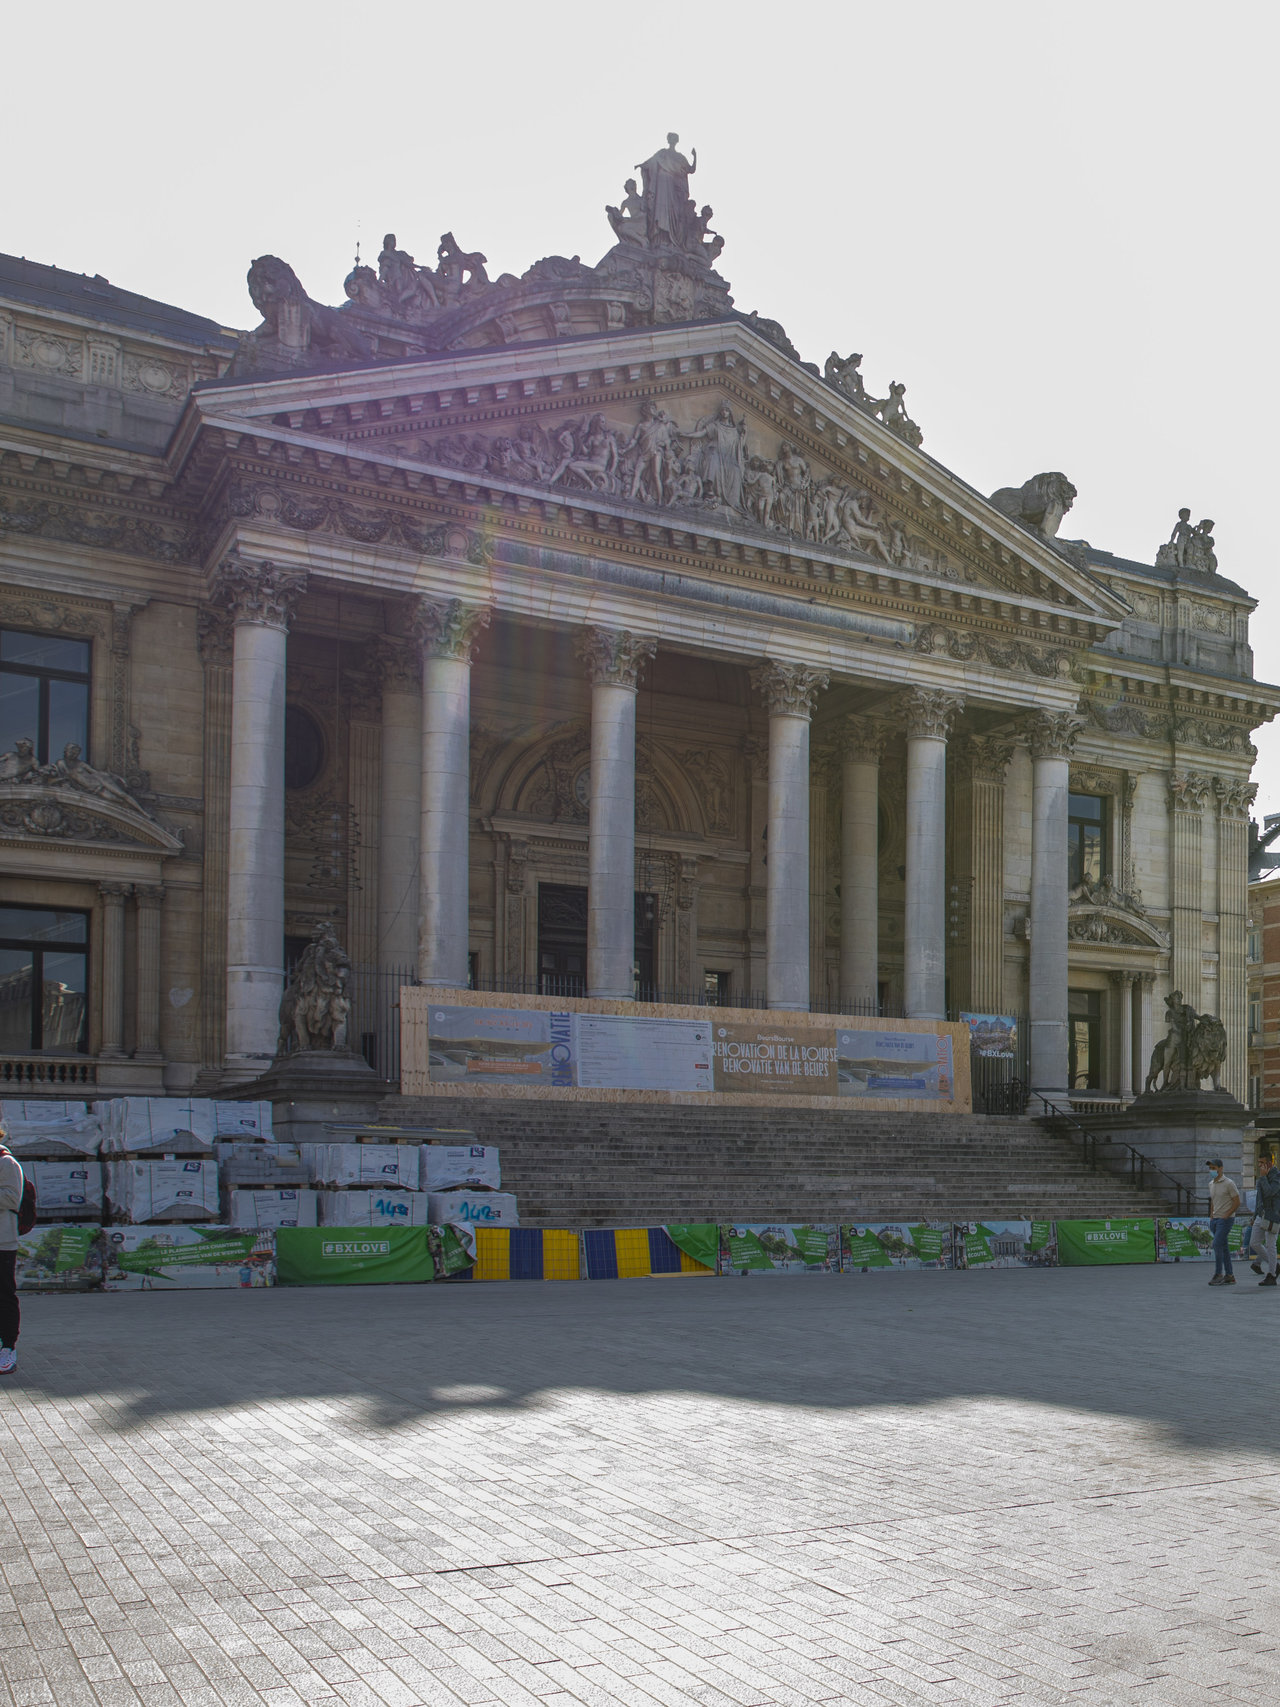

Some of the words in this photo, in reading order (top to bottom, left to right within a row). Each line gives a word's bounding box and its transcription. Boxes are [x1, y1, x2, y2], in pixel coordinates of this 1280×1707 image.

[777, 1045, 788, 1060] DE
[790, 1046, 800, 1061] LA
[802, 1047, 838, 1063] BOURSE
[774, 1060, 791, 1075] VAN
[792, 1061, 803, 1076] DE
[804, 1061, 829, 1077] BEURS
[1086, 1232, 1126, 1241] #BXLOVE
[324, 1242, 388, 1254] #BXLOVE
